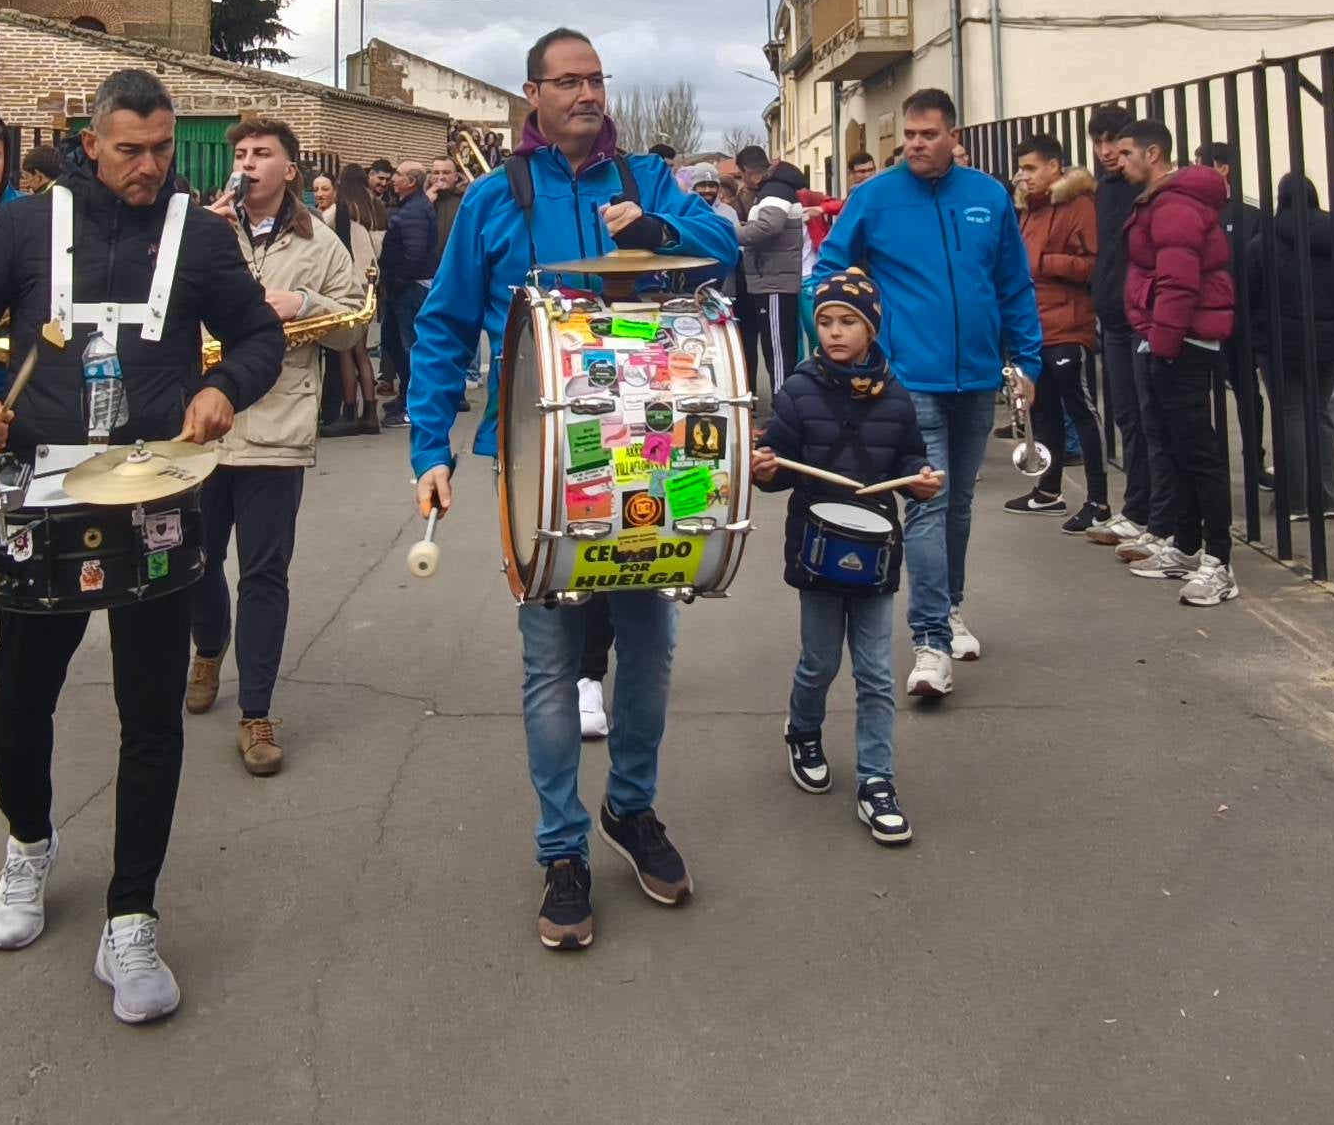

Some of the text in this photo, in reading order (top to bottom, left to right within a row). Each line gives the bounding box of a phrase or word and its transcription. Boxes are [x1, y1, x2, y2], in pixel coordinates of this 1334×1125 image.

[584, 541, 692, 563] CEDO
[619, 563, 651, 572] POR
[575, 571, 685, 587] HUELGA
